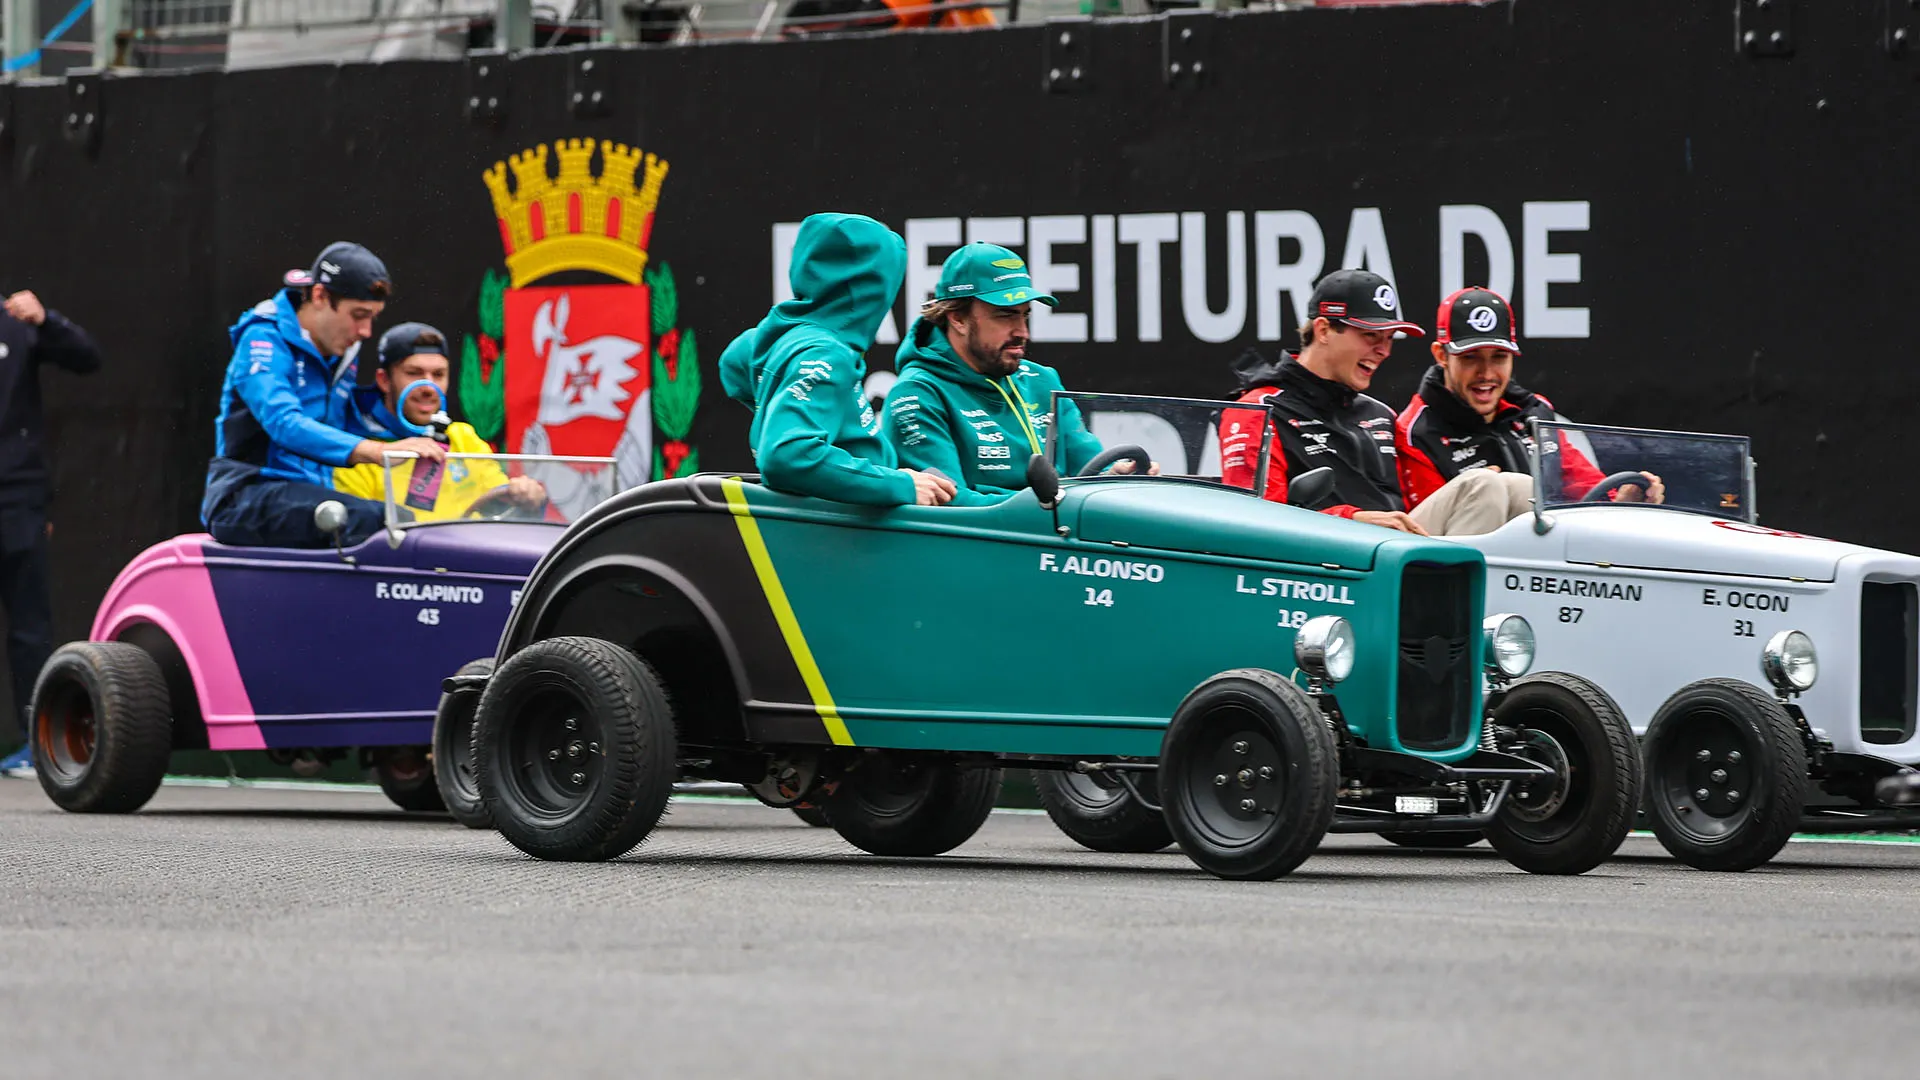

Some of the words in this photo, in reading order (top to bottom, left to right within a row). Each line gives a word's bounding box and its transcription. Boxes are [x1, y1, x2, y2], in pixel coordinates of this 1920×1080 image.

[1439, 201, 1591, 339] DE
[1003, 291, 1027, 302] 14
[1039, 552, 1059, 572] F.
[1061, 555, 1165, 583] ALONSO
[376, 582, 390, 599] F.
[391, 583, 484, 604] COLAPINTO
[1084, 587, 1115, 607] 14
[1236, 574, 1257, 594] L.
[1261, 577, 1355, 605] STROLL
[1505, 574, 1524, 591] O.
[1530, 576, 1643, 602] BEARMAN
[1702, 588, 1721, 606] E.
[1727, 591, 1790, 613] OCON
[417, 608, 440, 625] 43
[1277, 609, 1308, 629] 18
[1558, 606, 1584, 625] 87
[1733, 619, 1756, 638] 31
